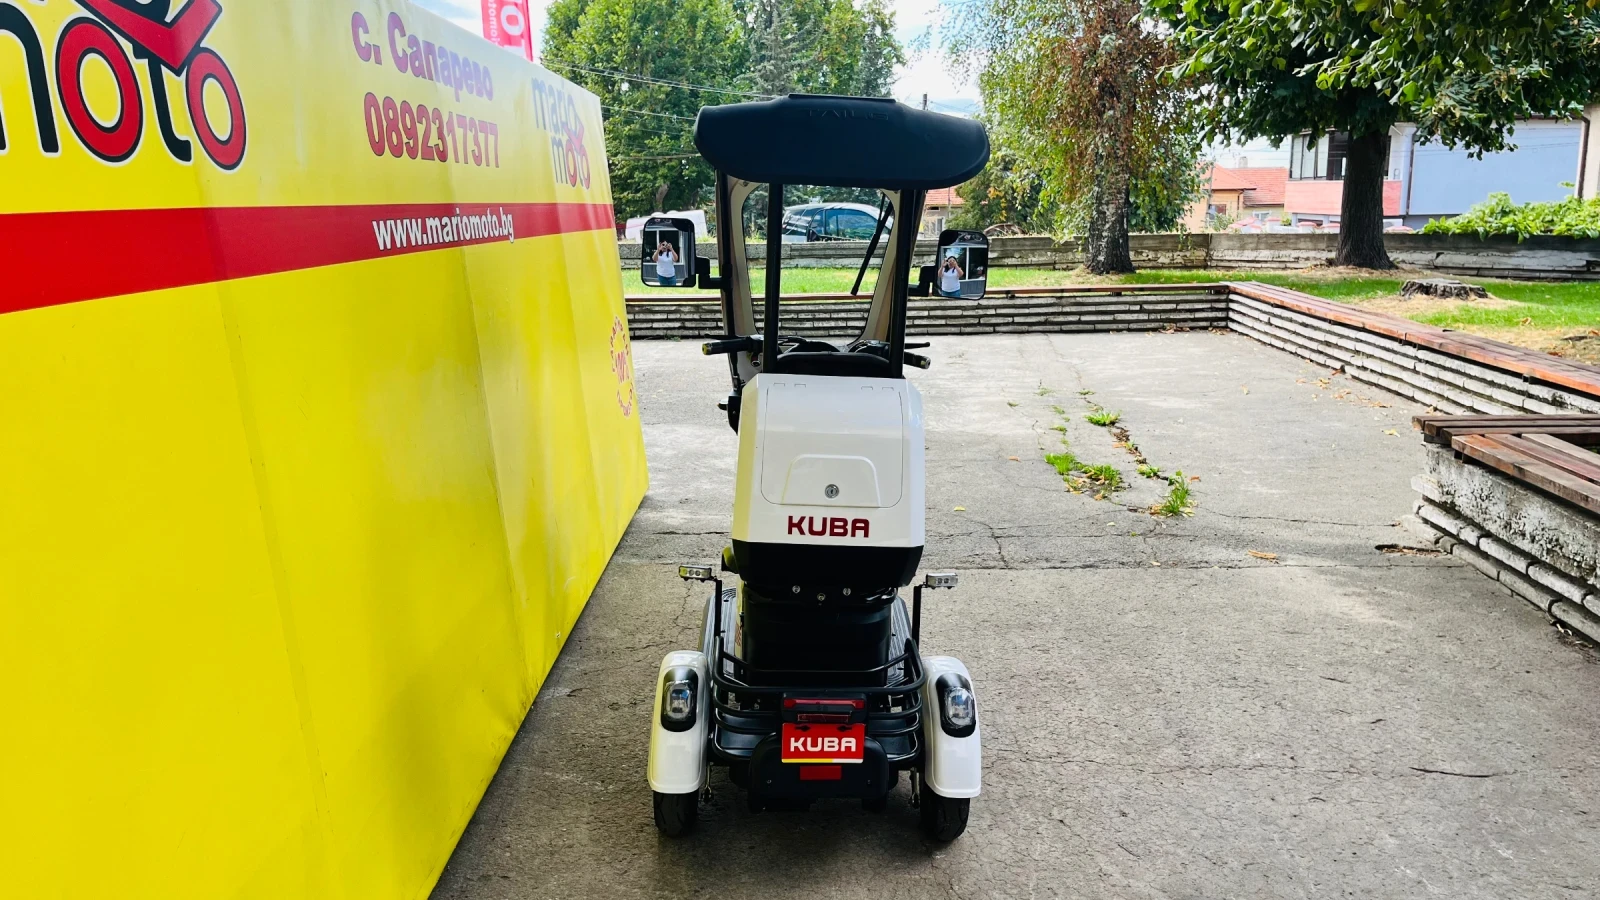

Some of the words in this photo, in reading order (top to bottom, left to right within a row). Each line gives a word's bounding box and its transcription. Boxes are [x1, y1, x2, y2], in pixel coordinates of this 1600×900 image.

[364, 92, 500, 168] 0892317377
[531, 76, 578, 137] mario
[551, 134, 590, 190] moto
[372, 207, 515, 251] www.mariomoto.bg
[787, 515, 870, 538] KUBA
[790, 737, 857, 752] KUBA
